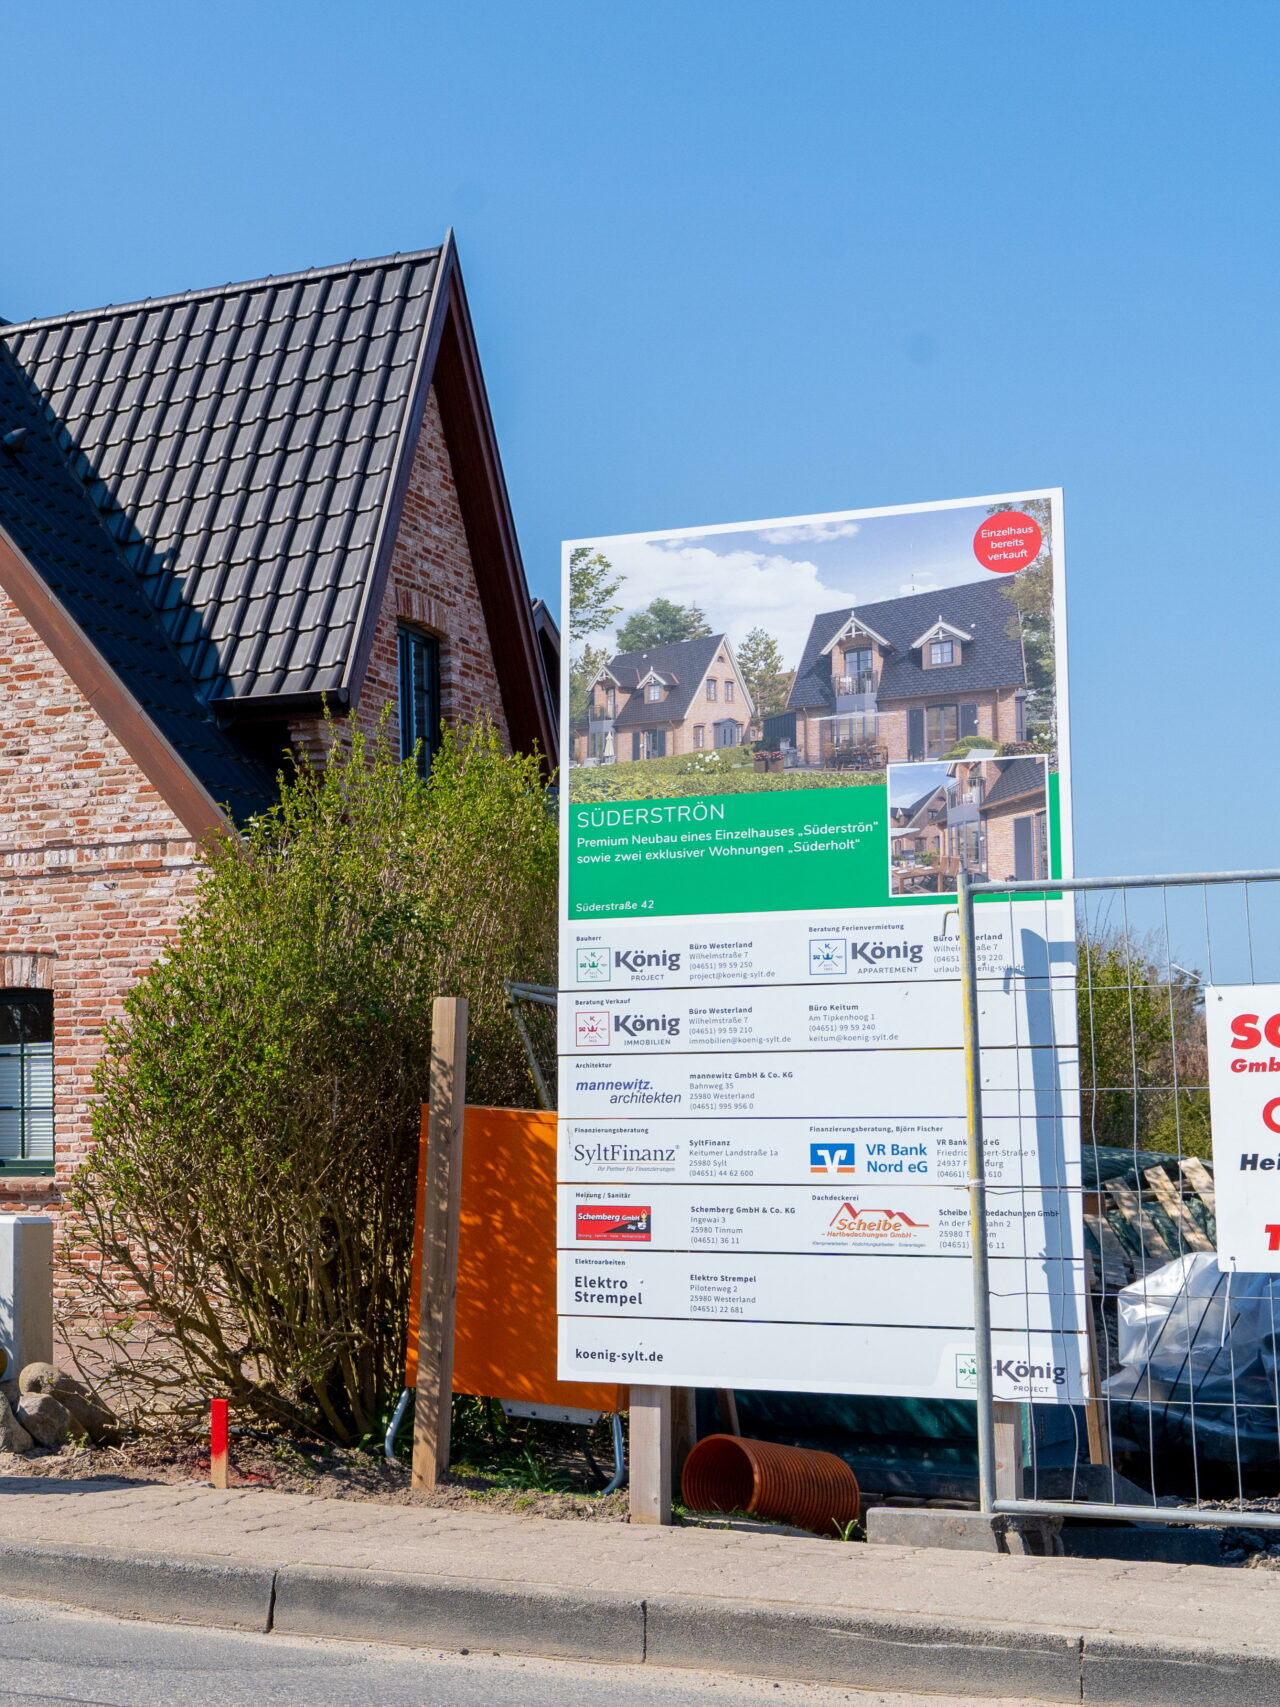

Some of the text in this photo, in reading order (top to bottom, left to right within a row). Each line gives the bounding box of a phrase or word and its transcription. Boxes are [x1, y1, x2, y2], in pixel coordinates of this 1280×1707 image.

[981, 526, 1034, 538] Einzelhaus
[991, 539, 1024, 549] bereits
[987, 550, 1028, 561] verkauft
[576, 801, 725, 828] SÜDERSTRÖN
[577, 836, 628, 848] Premium
[631, 834, 677, 846] Neubau
[680, 832, 712, 844] eines
[715, 827, 795, 841] Einzelhauses
[577, 852, 611, 864] sowie
[614, 850, 642, 862] zwei
[645, 847, 705, 861] exklusiver
[708, 844, 784, 858] Wohnungen
[576, 900, 655, 913] Süderstraße 42
[808, 923, 905, 934] Beratung Ferienvermietung
[709, 941, 753, 949] Westerland
[689, 952, 742, 960] Wilhelmstraße
[851, 941, 923, 964] König
[989, 953, 1003, 961] 220
[615, 950, 681, 972] König
[689, 962, 716, 971] (04651)
[857, 966, 918, 974] APPARTEMENT
[631, 974, 665, 982] PROJECT
[689, 970, 775, 980] project@koenig-sylt.de
[709, 1006, 753, 1014] Westerland
[808, 1003, 859, 1012] Büro Keitum
[689, 1016, 742, 1025] Wilhelmstraße
[823, 1013, 869, 1022] Tipkenhoog
[614, 1014, 681, 1036] König
[809, 1024, 837, 1032] (04651)
[862, 1023, 875, 1031] 240
[689, 1035, 792, 1045] immobilien@koenig-sylt.de
[809, 1033, 899, 1043] keitum@koenig-sylt.de
[734, 1071, 758, 1079] GmbH
[575, 1079, 653, 1091] mannewitz.
[689, 1082, 723, 1090] Bahnweg
[610, 1091, 682, 1104] architekten
[689, 1103, 717, 1111] (04651)
[574, 1127, 649, 1135] Finanzierungsberatung
[809, 1125, 894, 1134] Finanzierungsberatung,
[895, 1125, 916, 1133] Björn
[689, 1139, 730, 1148] SyltFinanz
[866, 1143, 927, 1156] VR Bank
[713, 1160, 727, 1168] Sylt
[867, 1160, 928, 1173] Nord eG
[575, 1192, 602, 1200] Heizung
[691, 1206, 734, 1214] Schemberg
[577, 1213, 620, 1222] Schemberg
[836, 1218, 902, 1231] Scheibe
[939, 1230, 963, 1238] 25980
[575, 1258, 626, 1266] Elektroarbeiten
[574, 1276, 628, 1289] Elektro
[720, 1275, 756, 1283] Strempel
[690, 1284, 732, 1293] Pilotenweg
[574, 1291, 643, 1306] Strempel
[713, 1295, 756, 1303] Westerland
[690, 1305, 718, 1313] (04651)
[730, 1306, 744, 1314] 681
[575, 1349, 664, 1363] koenig-sylt.de
[996, 1360, 1066, 1384] König
[1013, 1385, 1049, 1393] PROJECT
